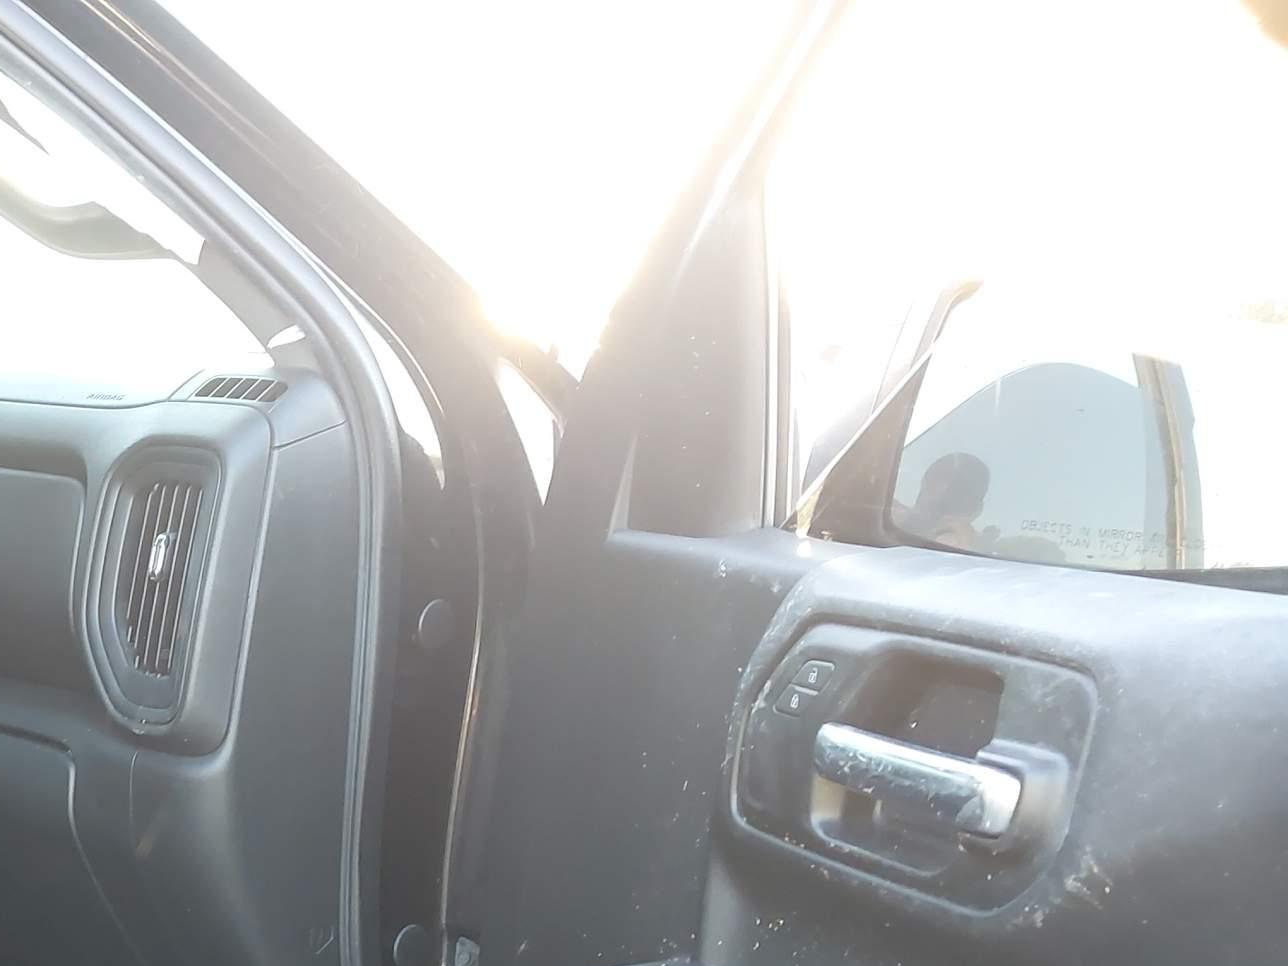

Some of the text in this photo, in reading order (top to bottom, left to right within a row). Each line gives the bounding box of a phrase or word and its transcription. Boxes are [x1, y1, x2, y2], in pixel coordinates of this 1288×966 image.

[1020, 519, 1072, 534] OBJECTS
[1079, 524, 1090, 537] IN
[1097, 528, 1144, 543] MIRROR
[1059, 535, 1089, 549] THAN
[1099, 539, 1129, 553] THEY
